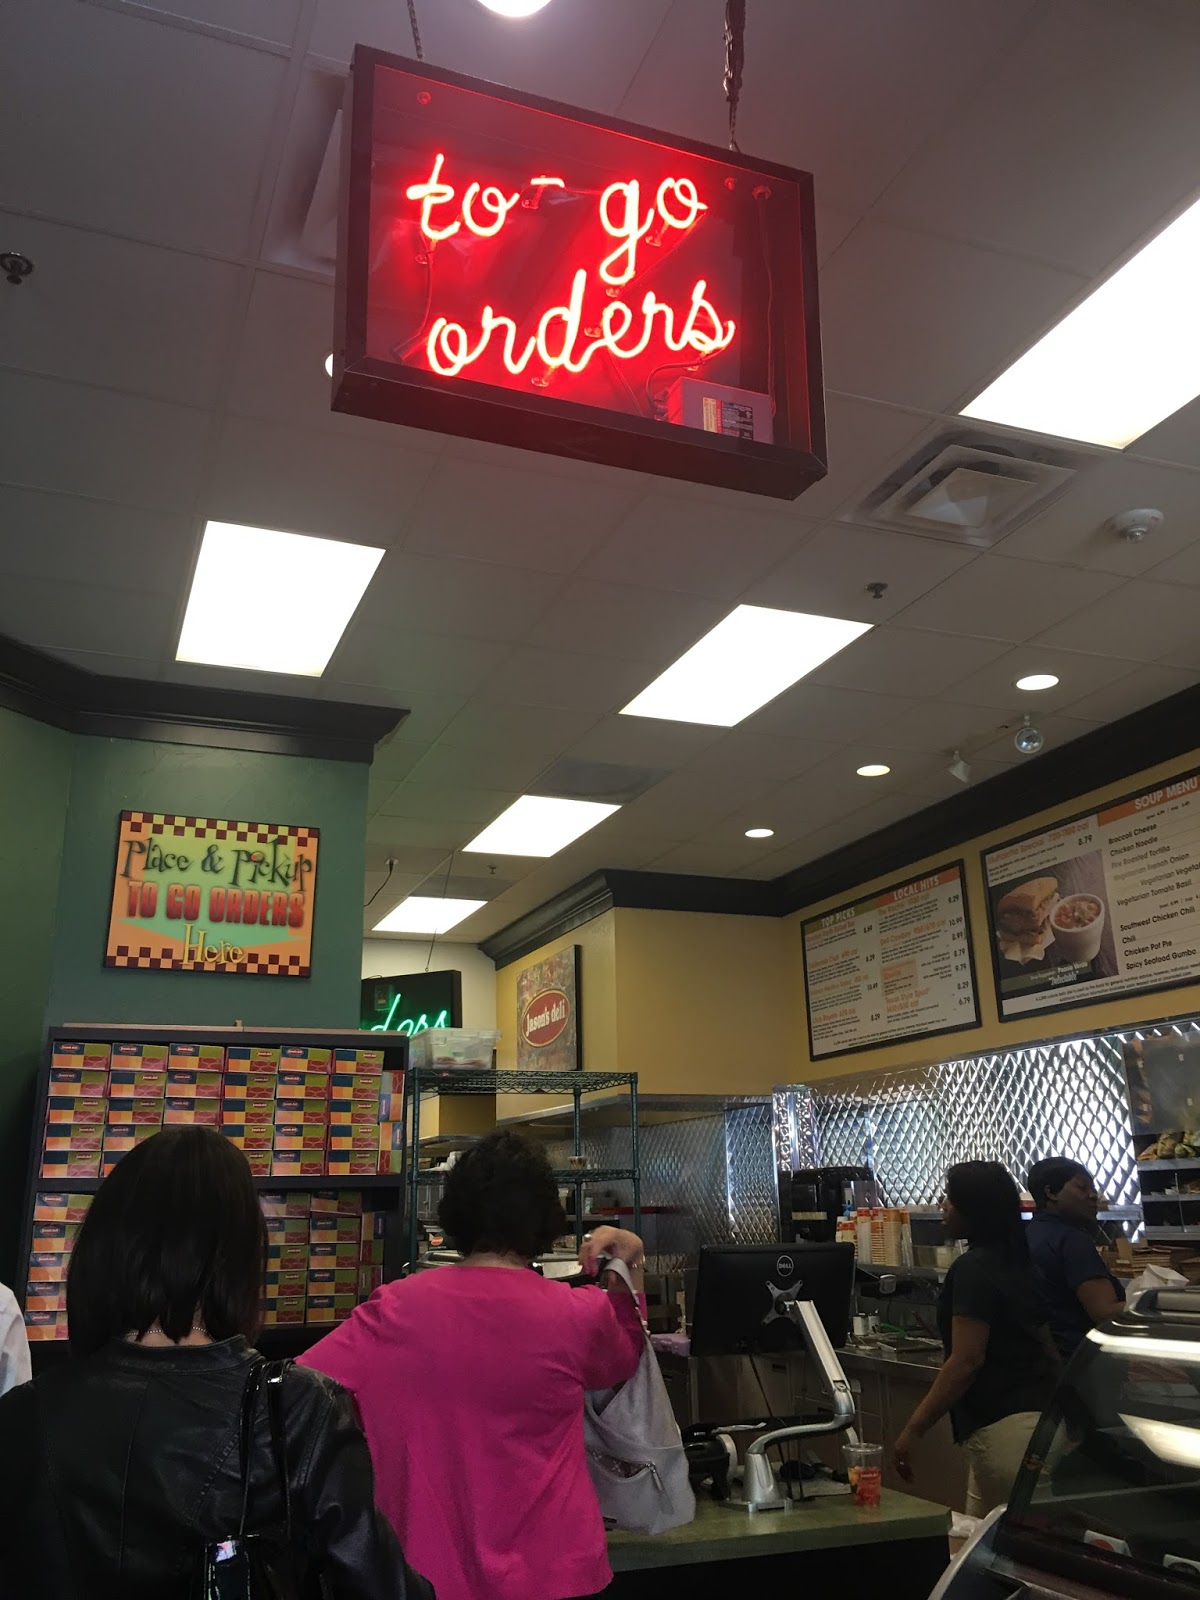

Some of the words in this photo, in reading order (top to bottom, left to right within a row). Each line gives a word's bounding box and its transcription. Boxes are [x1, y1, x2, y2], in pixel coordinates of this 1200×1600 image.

[427, 269, 735, 376] orders
[1135, 791, 1163, 810] SOUP
[1166, 777, 1198, 798] MENU
[1078, 834, 1093, 846] 8.79
[1108, 832, 1132, 845] Broccoli
[1133, 824, 1157, 836] Cheese
[119, 837, 194, 878] Place
[201, 844, 226, 875] &
[1110, 844, 1134, 857] Chicken
[1135, 837, 1158, 848] Noodle
[1149, 845, 1170, 857] Tortilla
[1169, 853, 1190, 864] Onion
[893, 885, 918, 901] LOCAL
[920, 875, 940, 891] HITS
[1116, 891, 1150, 907] Vegetarian
[1150, 884, 1175, 896] Tomato
[1176, 879, 1192, 889] Basil
[128, 881, 159, 918] TO
[166, 884, 200, 921] GO
[209, 887, 305, 928] ORDERS
[821, 915, 834, 928] TOP
[836, 907, 856, 922] PICKS
[1120, 918, 1151, 931] Southwest
[1152, 911, 1179, 923] Chicken
[1179, 906, 1196, 916] Chili
[179, 924, 247, 966] Here
[1122, 935, 1137, 944] Chili
[1124, 946, 1150, 957] Chicken
[1150, 940, 1161, 950] Pot
[1162, 940, 1173, 948] Pie
[1125, 960, 1143, 970] Spicy
[1143, 953, 1171, 966] Seafood
[1171, 948, 1197, 960] Gumbo
[525, 1006, 551, 1037] Jason's
[550, 998, 566, 1023] deli
